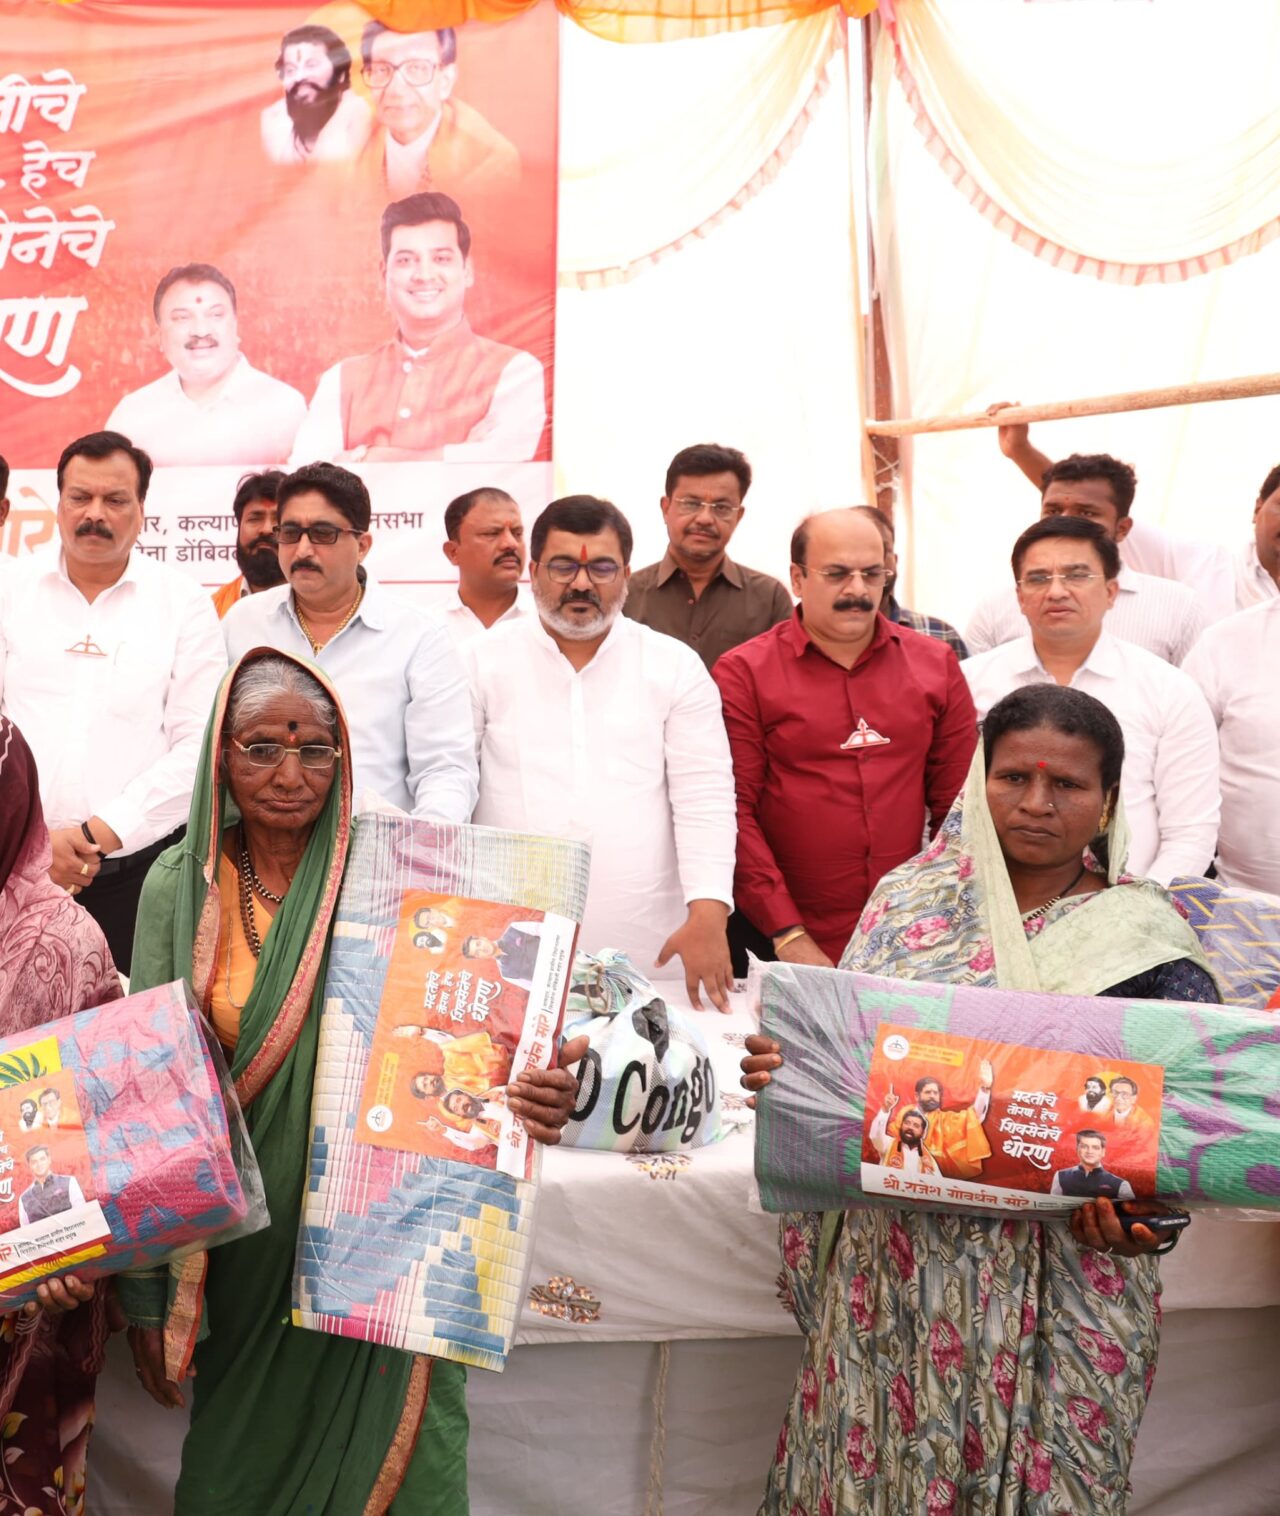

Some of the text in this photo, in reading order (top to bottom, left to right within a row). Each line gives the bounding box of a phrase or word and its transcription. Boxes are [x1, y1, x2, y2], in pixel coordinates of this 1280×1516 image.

[21, 140, 96, 199] हेच
[467, 977, 502, 1022] धोरण
[613, 1055, 716, 1145] Congo
[1012, 1090, 1059, 1107] मदतीचे
[999, 1117, 1063, 1142] शिवसेनेचे
[1002, 1135, 1055, 1170] धोरण
